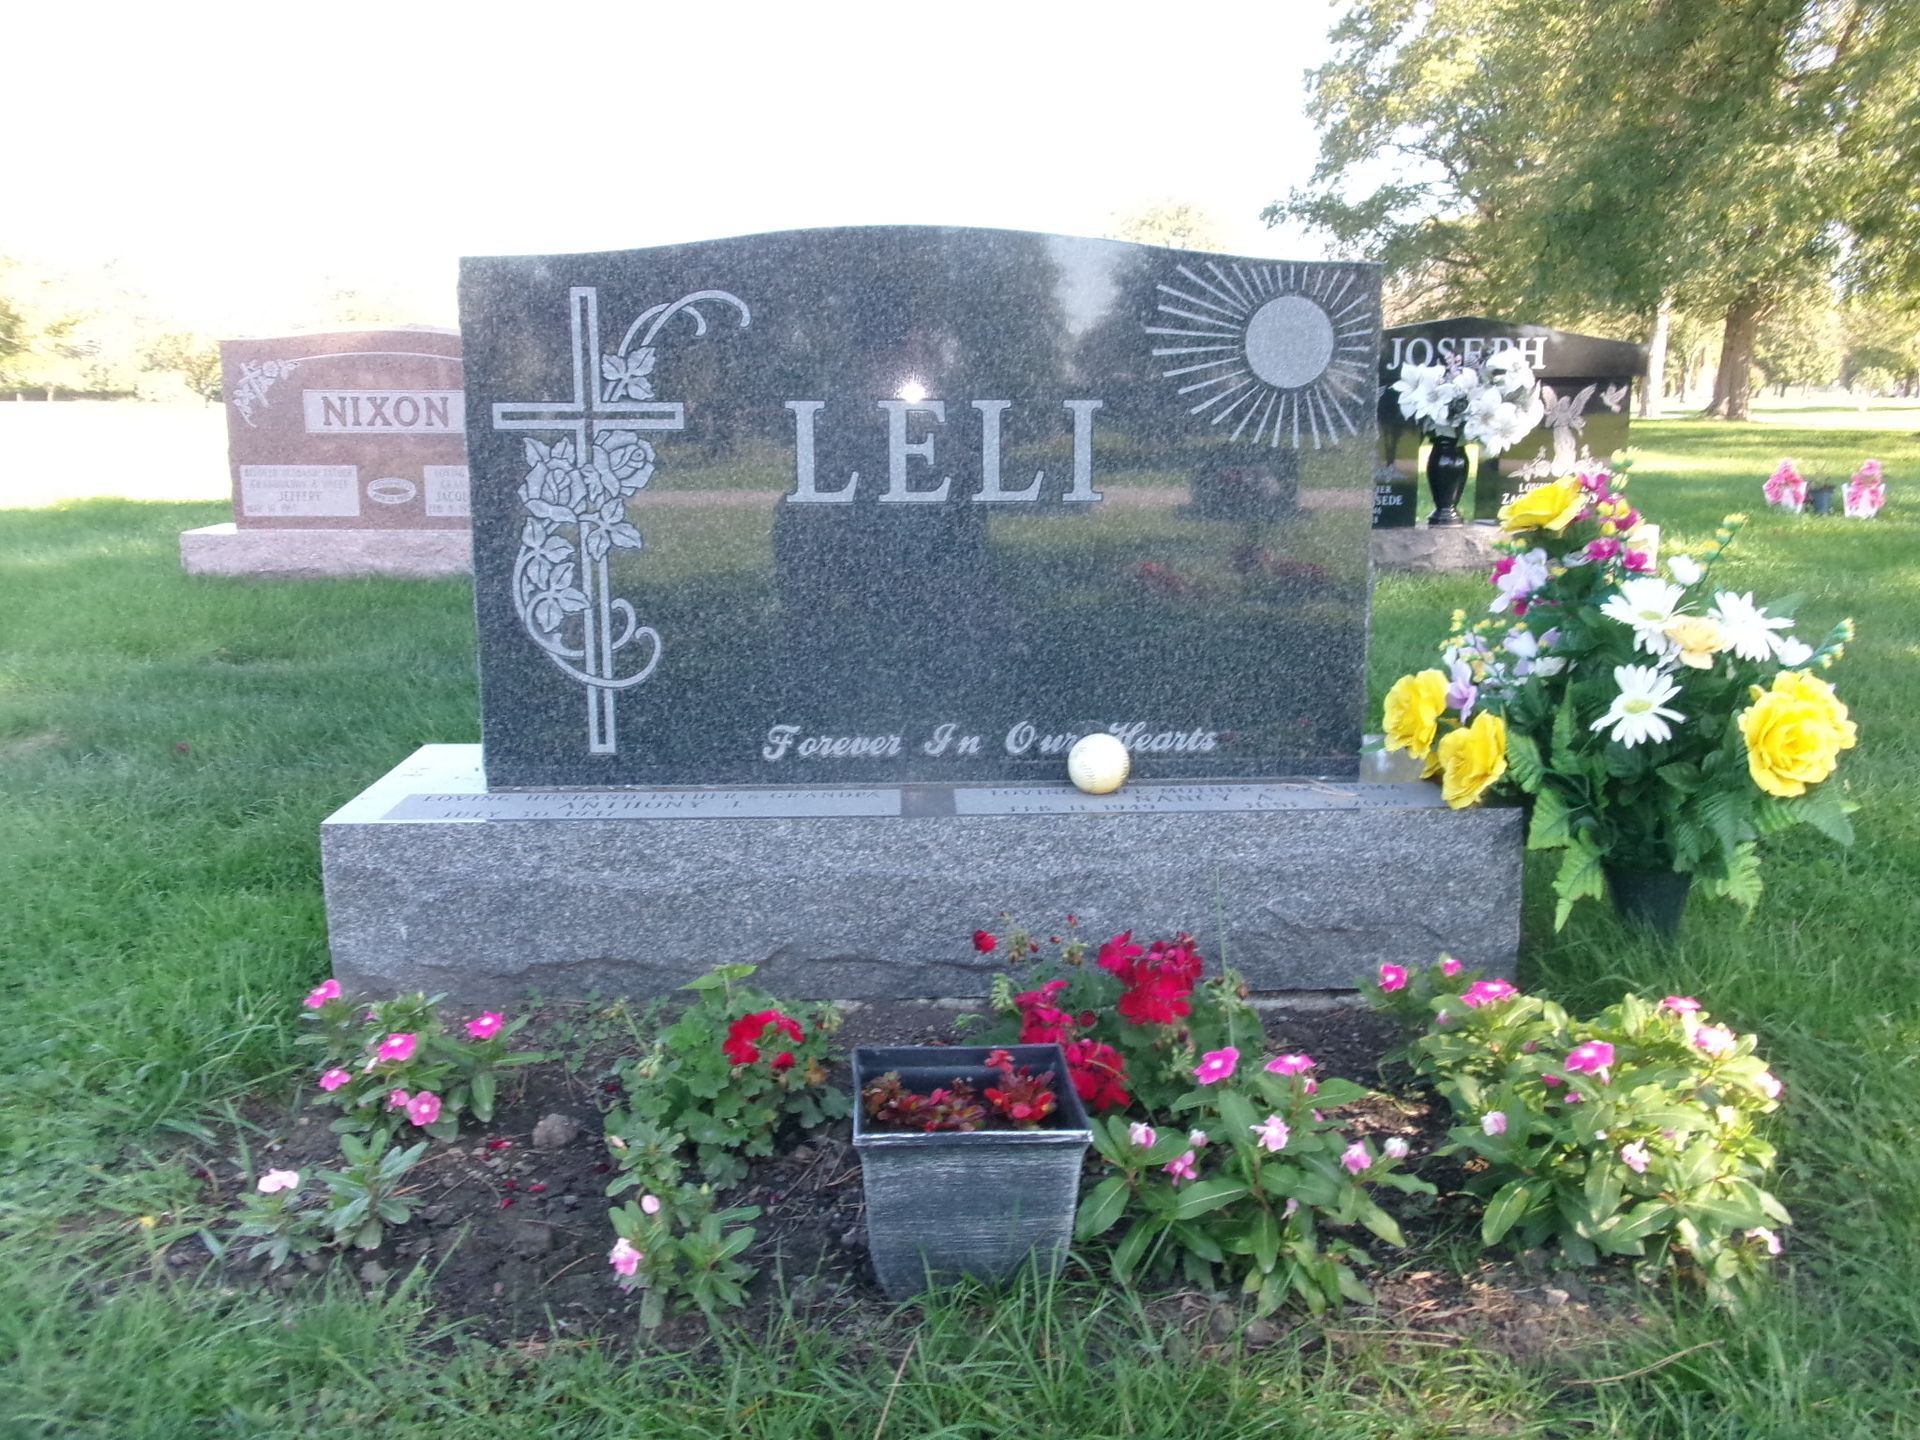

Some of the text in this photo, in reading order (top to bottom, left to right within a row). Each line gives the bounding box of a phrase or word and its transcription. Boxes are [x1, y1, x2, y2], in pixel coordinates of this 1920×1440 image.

[321, 396, 449, 428] NIXON
[784, 399, 1104, 504] LELI
[762, 720, 1218, 760] Forever In Our Hearts
[769, 791, 880, 799] GRANDPA
[1134, 794, 1229, 803] NANCY
[558, 801, 706, 809] ANTHONY
[443, 810, 502, 818] JULY
